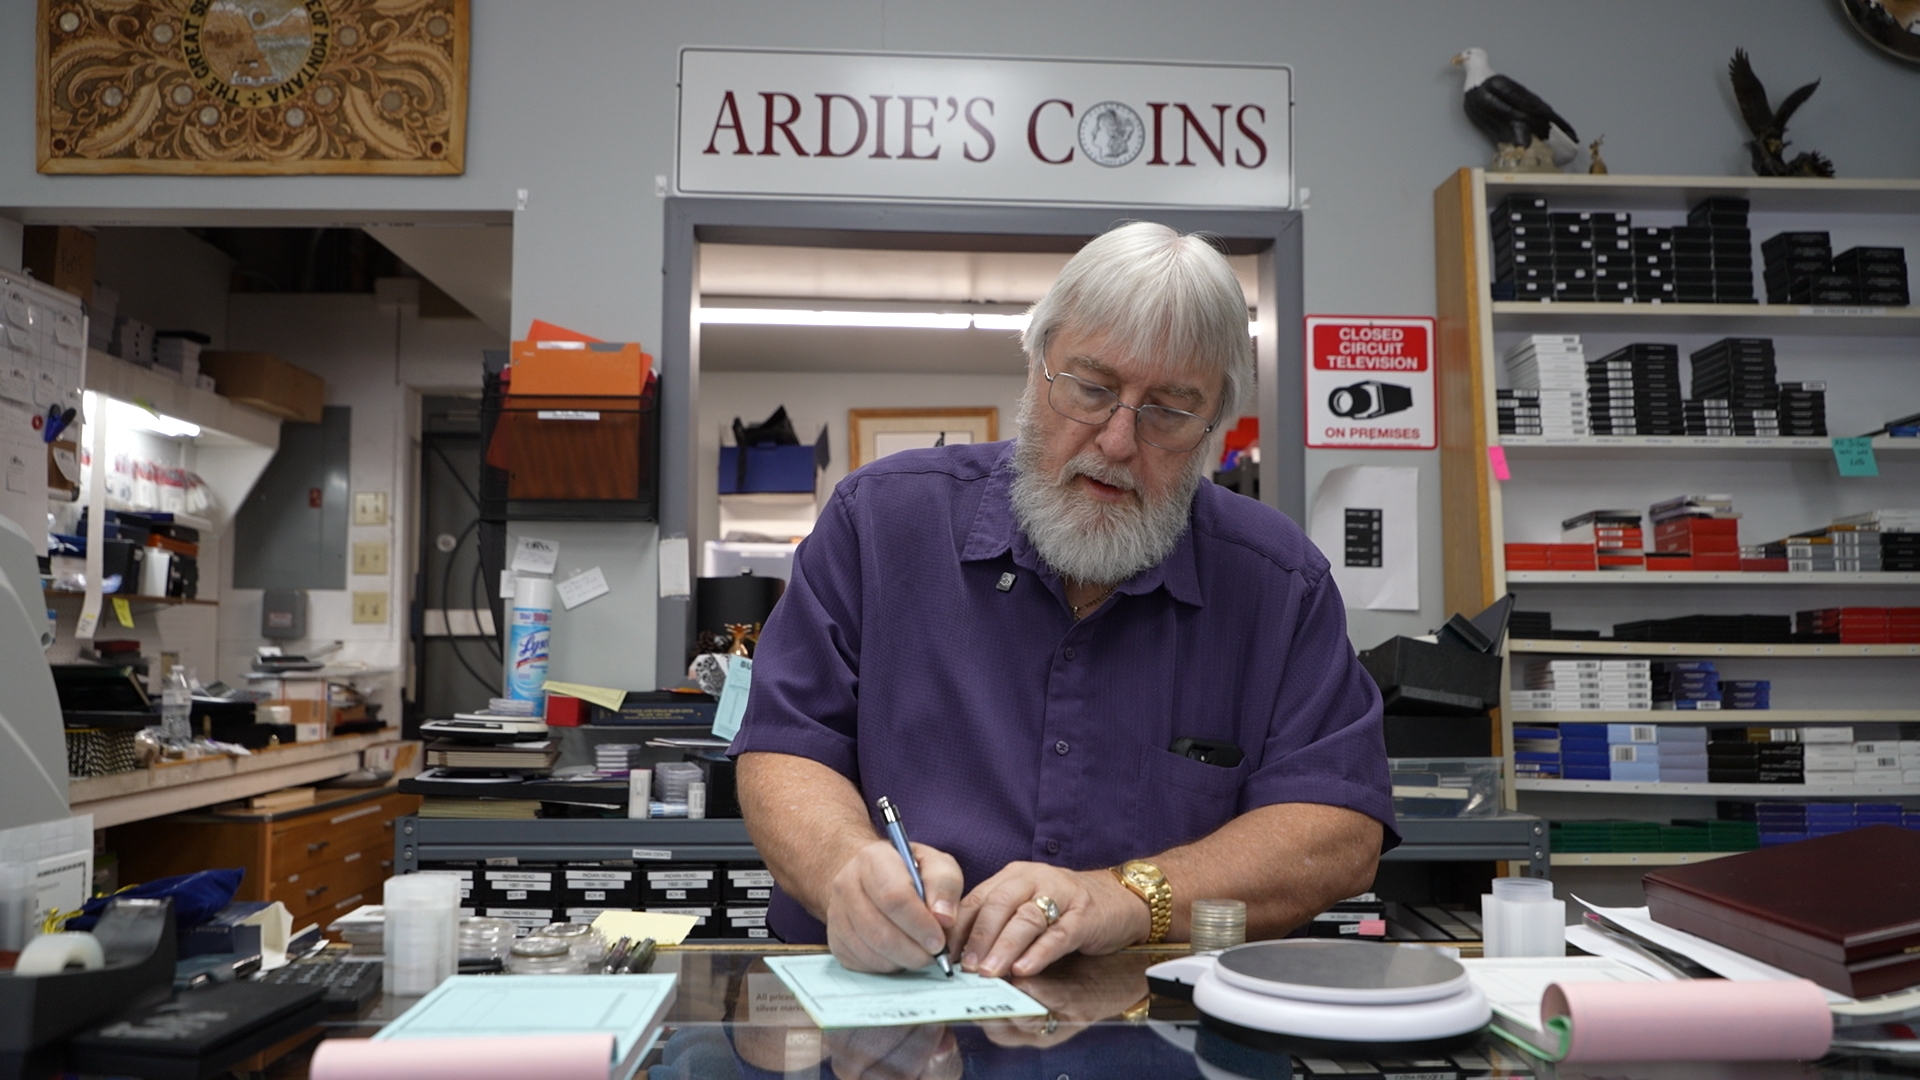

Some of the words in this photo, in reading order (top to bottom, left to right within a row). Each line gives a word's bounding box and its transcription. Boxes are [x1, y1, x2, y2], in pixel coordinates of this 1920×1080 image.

[311, 10, 329, 29] OF
[184, 20, 209, 79] GREAT
[266, 32, 330, 103] MONTANA
[205, 77, 240, 105] THE
[1338, 327, 1404, 341] CLOSED
[1338, 341, 1404, 355] CIRCUIT
[1326, 355, 1418, 369] TELEVISION
[1324, 427, 1346, 438] ON
[1350, 428, 1420, 439] PREMISES
[740, 660, 752, 670] BU
[769, 993, 796, 1002] priced
[756, 1004, 778, 1012] silver
[780, 1004, 805, 1012] mark
